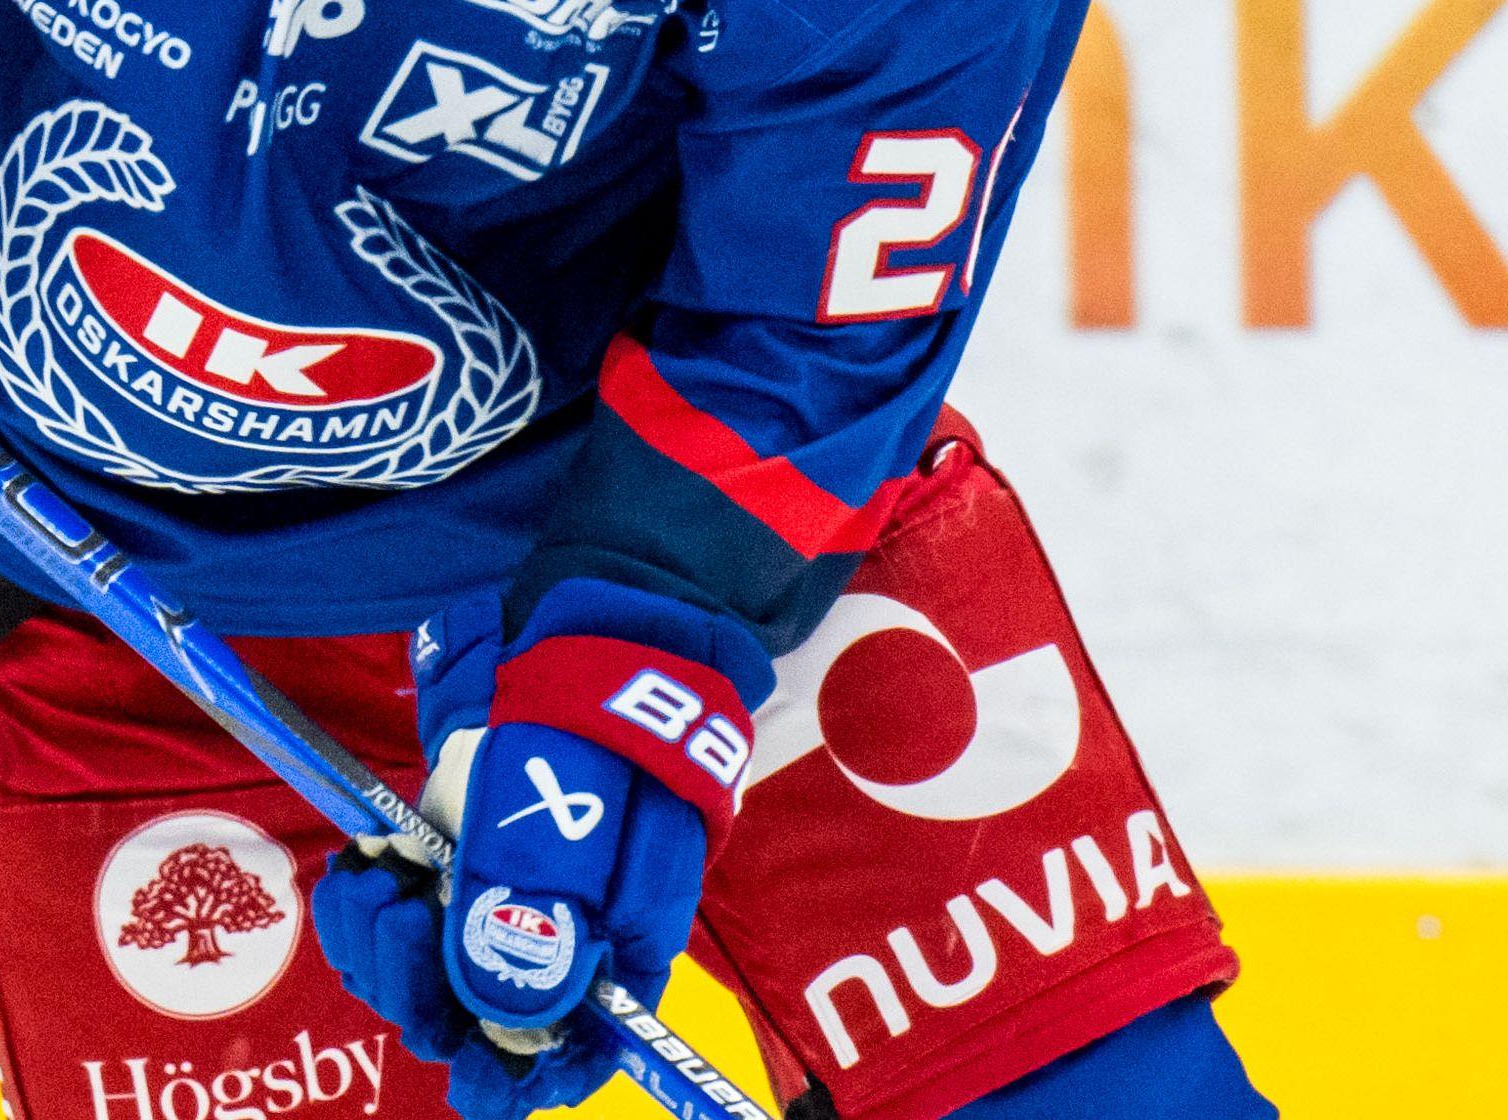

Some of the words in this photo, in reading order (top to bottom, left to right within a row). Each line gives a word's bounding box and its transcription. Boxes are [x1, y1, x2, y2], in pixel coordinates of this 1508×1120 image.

[380, 62, 559, 167] XL
[816, 85, 1030, 324] 2
[55, 282, 410, 443] OSKARSHAMN
[143, 291, 348, 397] IK
[509, 908, 549, 933] IK
[81, 1030, 388, 1120] Högsby
[625, 1014, 774, 1120] BAUER
